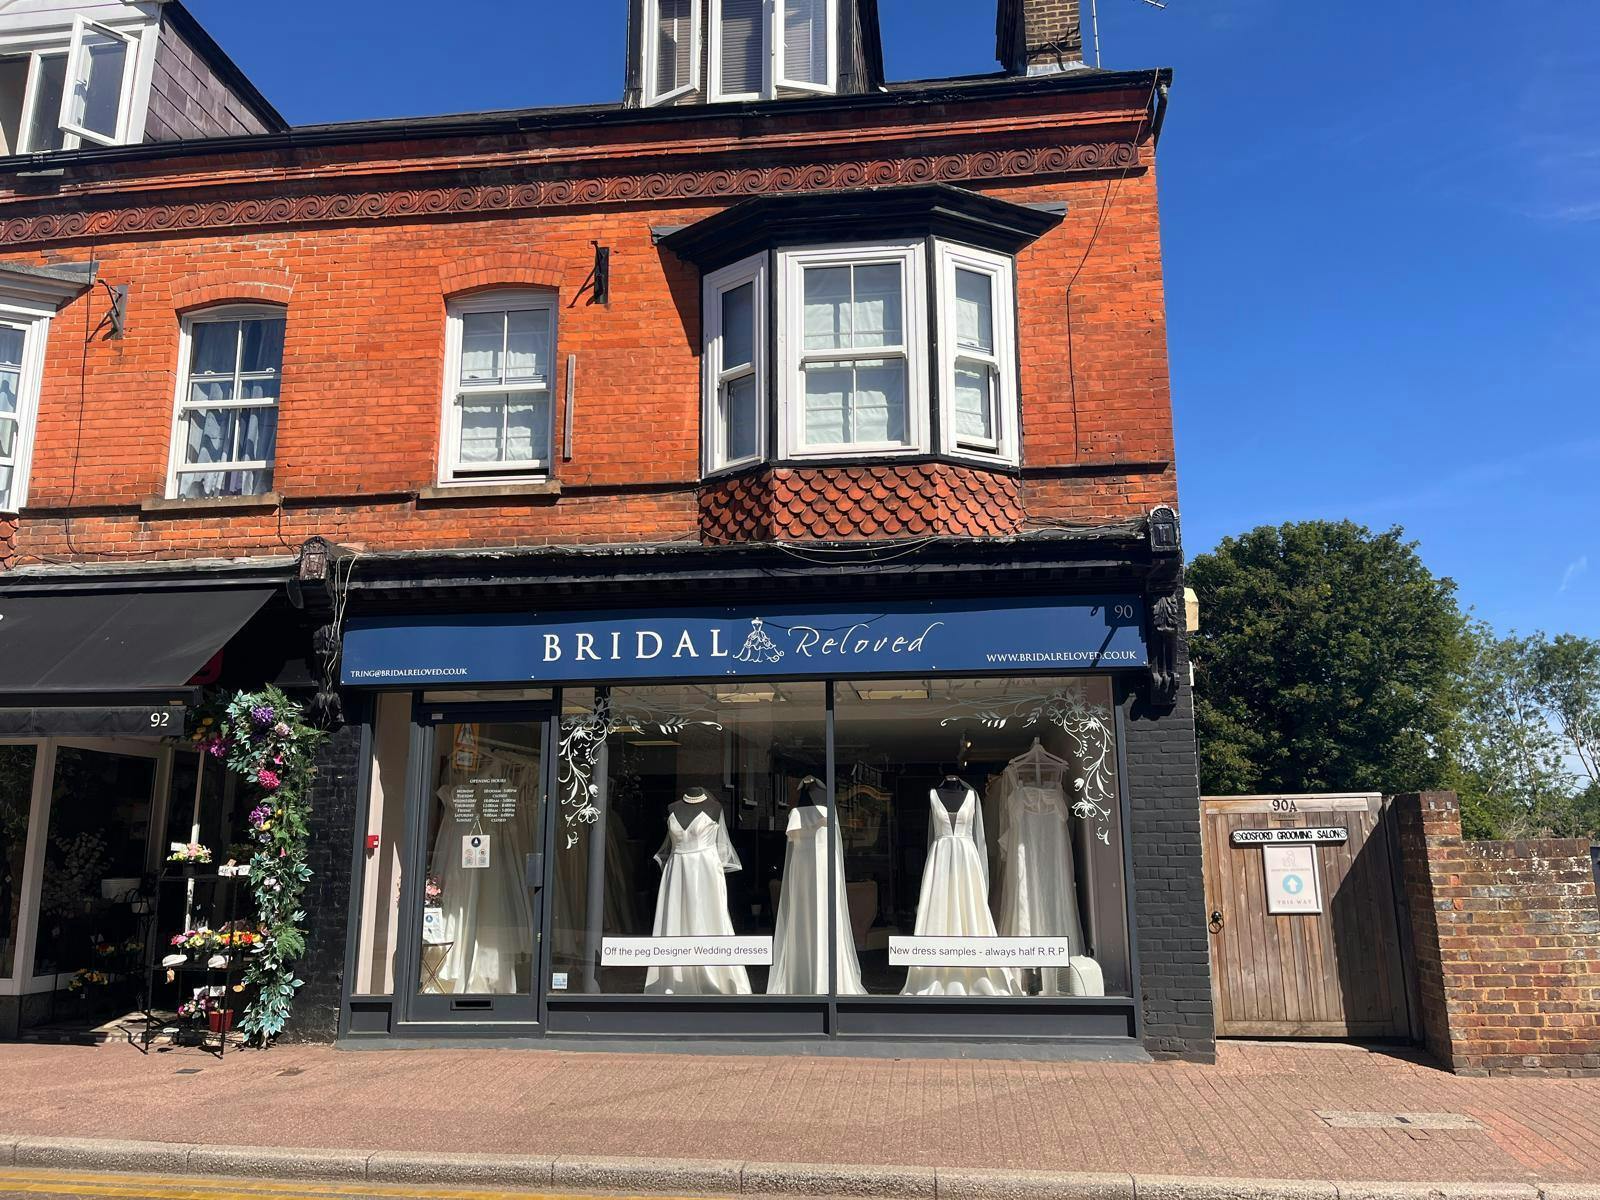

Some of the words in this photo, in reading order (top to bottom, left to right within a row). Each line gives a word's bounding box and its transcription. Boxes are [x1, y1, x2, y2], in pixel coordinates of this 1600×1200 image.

[1114, 604, 1134, 619] 90
[542, 628, 729, 662] BRIDAL
[788, 621, 945, 657] Reloved
[986, 650, 1137, 662] WWW.BRIDALRELOVED.CO.UK
[350, 667, 468, 678] TRING@BRIDALRELOVED.CO.UK
[150, 712, 170, 728] 92
[1272, 799, 1298, 812] 90A
[1241, 831, 1273, 841] GOSFORD
[1277, 830, 1313, 840] GROOMING
[1317, 829, 1340, 839] SALON
[604, 946, 617, 956] Off
[619, 946, 633, 956] the
[634, 948, 651, 957] peg
[653, 946, 692, 957] Designer
[694, 946, 732, 957] Wedding
[734, 946, 769, 955] dresses
[889, 946, 910, 956] New
[911, 946, 937, 956] dress
[938, 947, 977, 957] samples
[985, 947, 1017, 958] always
[1018, 946, 1036, 956] half
